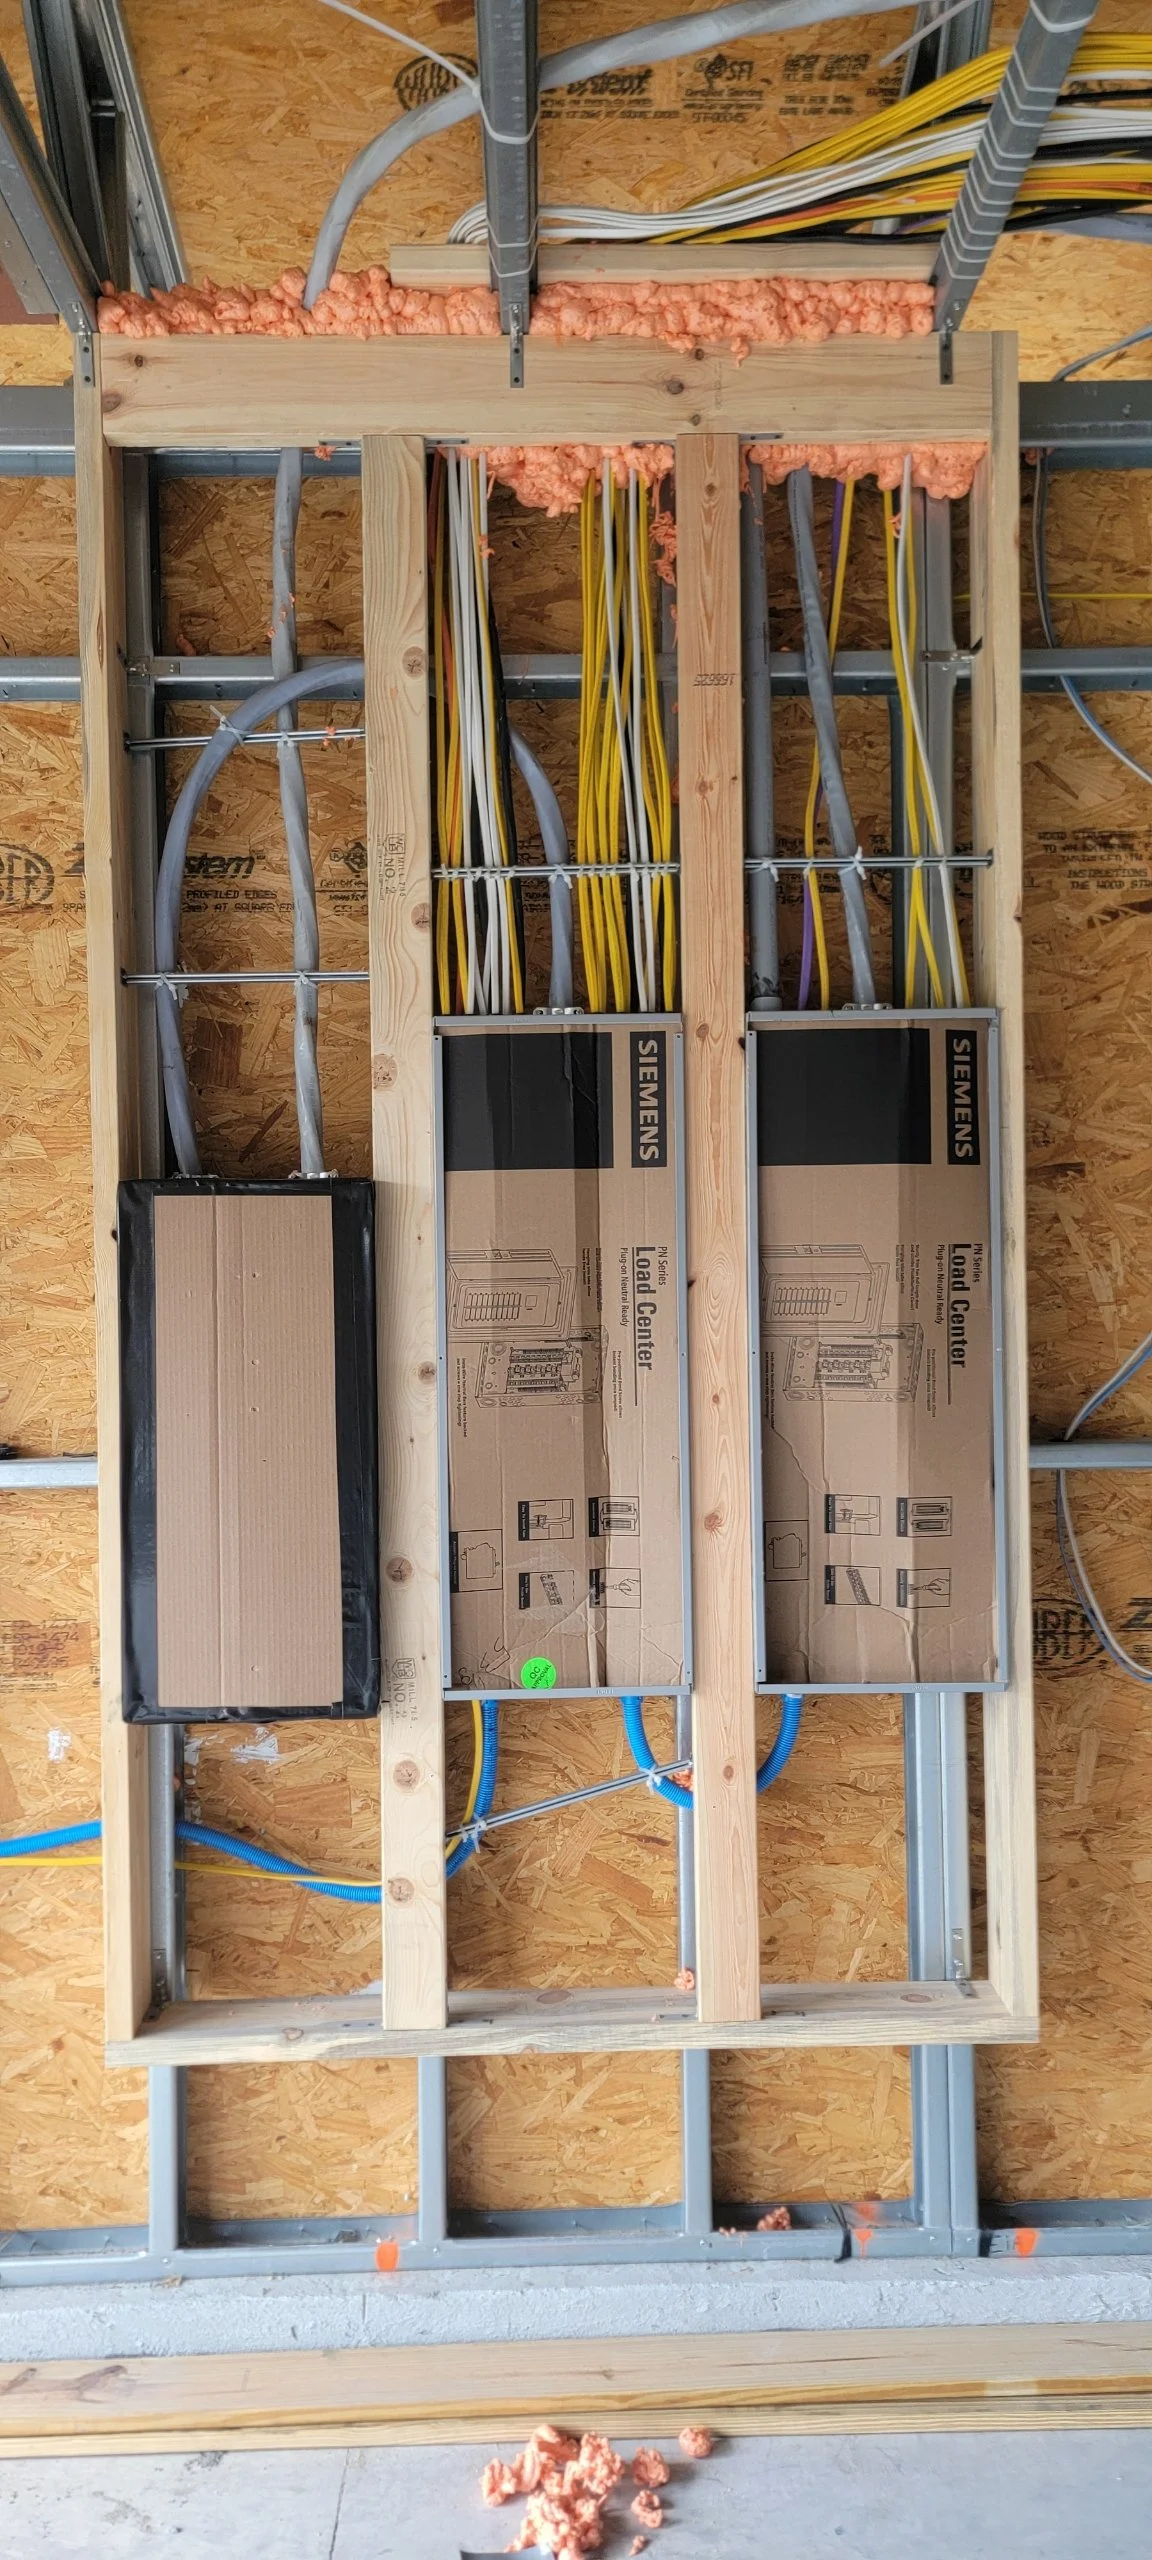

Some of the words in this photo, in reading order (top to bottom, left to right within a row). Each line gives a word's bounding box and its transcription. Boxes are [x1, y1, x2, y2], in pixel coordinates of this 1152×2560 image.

[385, 859, 395, 881] NO.
[186, 890, 239, 899] PROFILED
[245, 890, 278, 899] EDGES
[638, 1039, 659, 1162] SIEMENS
[953, 1038, 974, 1158] SIEMENS
[619, 1248, 628, 1275] Plug-on
[658, 1247, 668, 1258] PN
[936, 1245, 945, 1272] Plug-on
[974, 1244, 983, 1255] PN
[635, 1247, 656, 1294] Load
[658, 1261, 668, 1286] Series
[952, 1244, 972, 1291] Load
[973, 1257, 982, 1283] Series
[621, 1277, 629, 1304] Neutral
[936, 1274, 945, 1301] Neutral
[620, 1306, 629, 1327] Ready
[934, 1303, 945, 1325] Ready
[637, 1301, 657, 1371] Center
[951, 1299, 970, 1368] Center
[529, 1666, 541, 1679] QC
[393, 1683, 406, 1706] NO.
